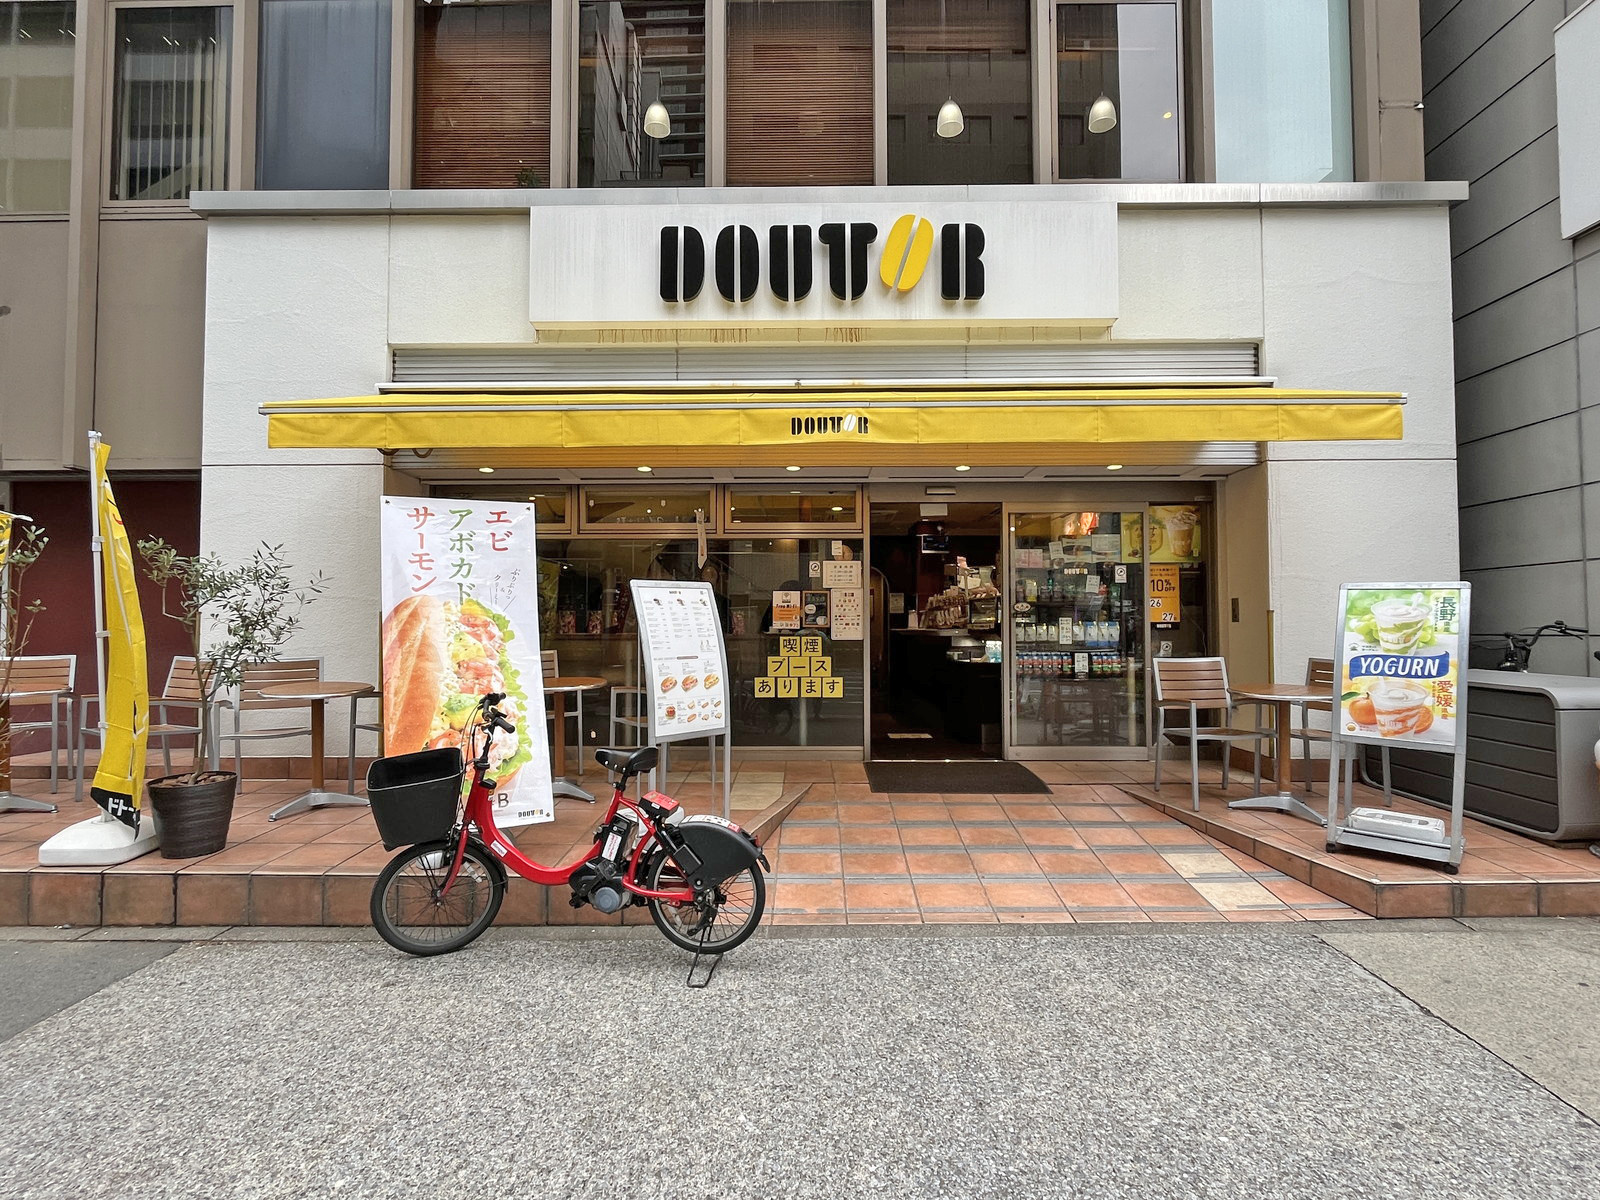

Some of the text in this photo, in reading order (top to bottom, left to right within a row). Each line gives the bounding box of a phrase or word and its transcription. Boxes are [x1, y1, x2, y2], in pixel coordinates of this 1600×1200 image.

[659, 213, 986, 303] DOUTOR
[791, 413, 869, 435] DOUTOR
[485, 510, 513, 552] エビ
[406, 506, 437, 592] サーモン
[449, 509, 476, 606] アボカド
[782, 638, 820, 653] 喫煙
[771, 658, 828, 673] ブース
[1360, 657, 1439, 677] YOGURN
[758, 679, 840, 694] あります
